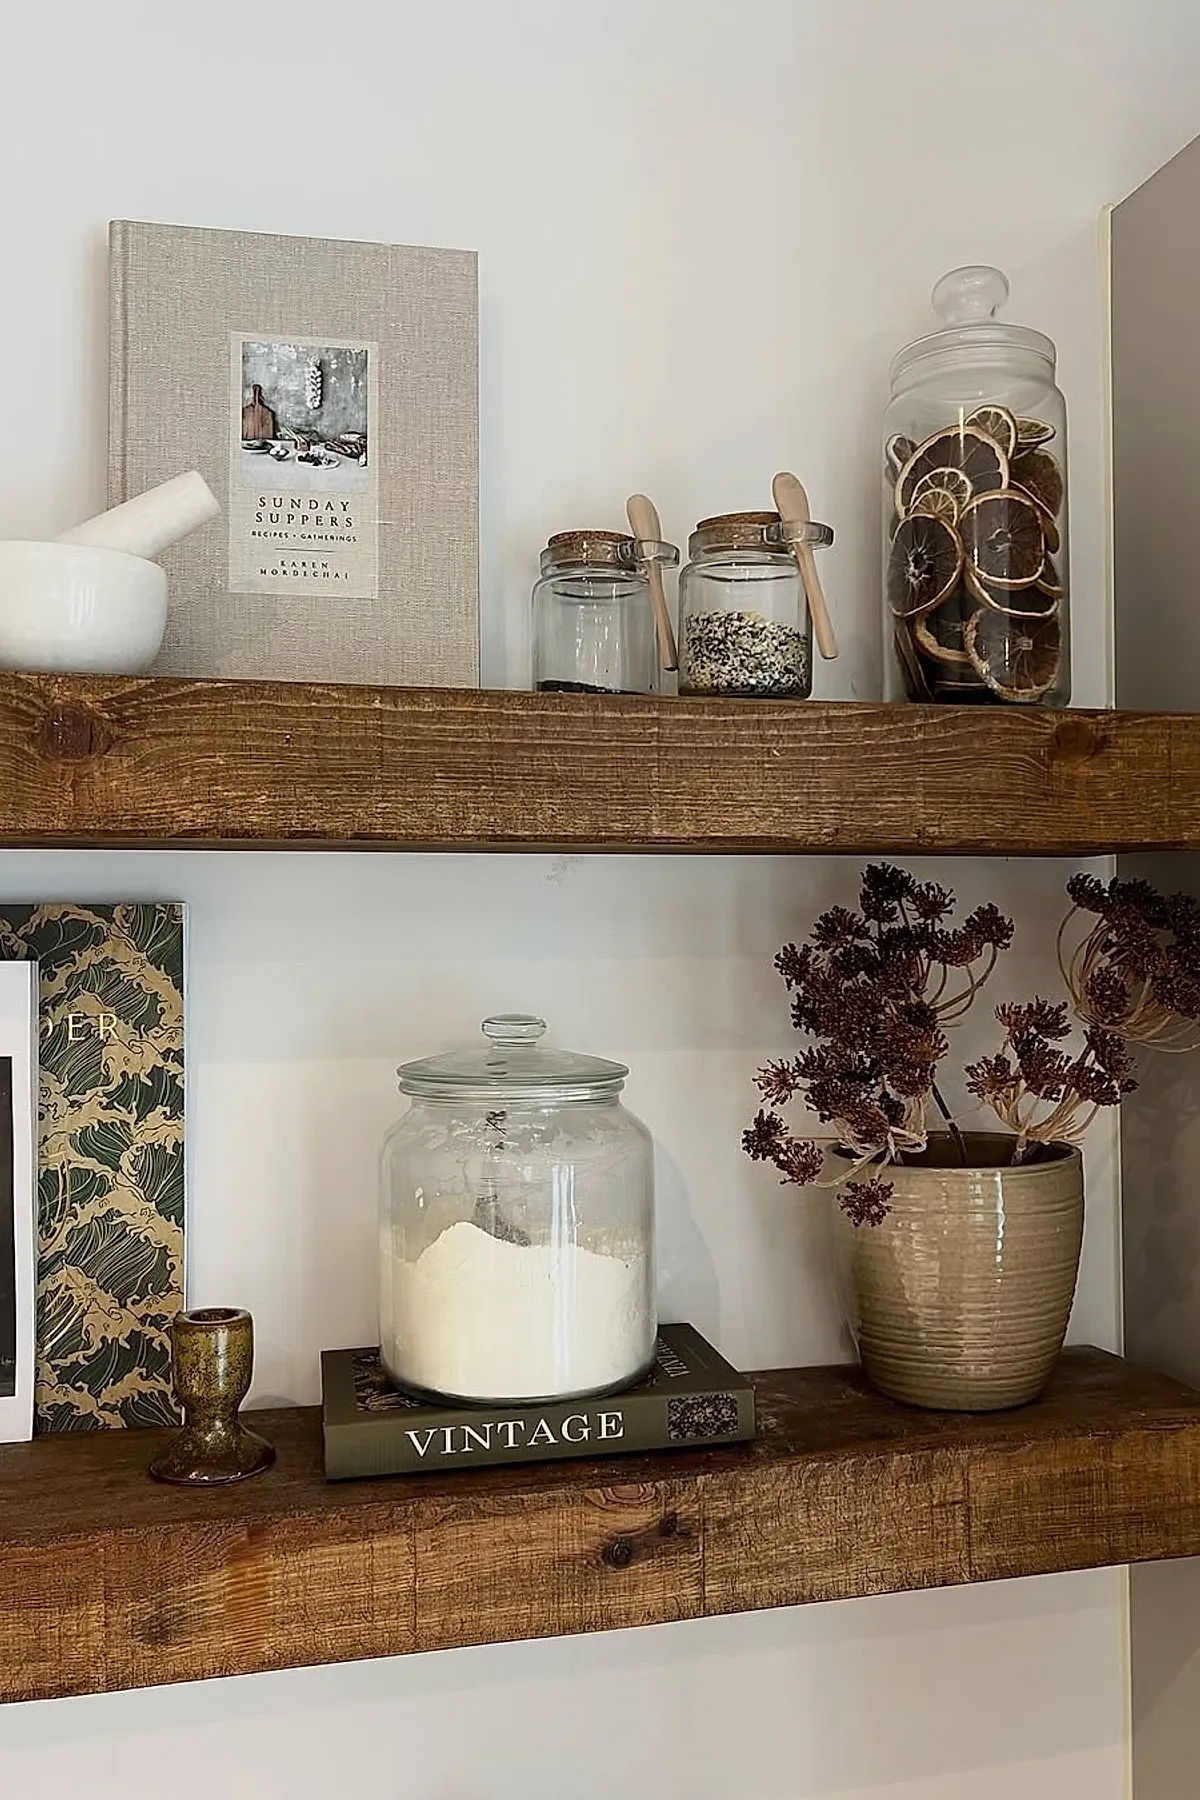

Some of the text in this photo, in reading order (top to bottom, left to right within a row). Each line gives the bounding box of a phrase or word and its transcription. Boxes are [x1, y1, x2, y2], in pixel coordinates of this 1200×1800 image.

[258, 496, 350, 512] SUNDAY
[255, 512, 354, 528] SUPPERS
[251, 530, 289, 539] RECIPES
[300, 533, 358, 543] GATHERINGS
[280, 560, 329, 569] KAREN
[404, 1411, 625, 1458] VINTAGE
